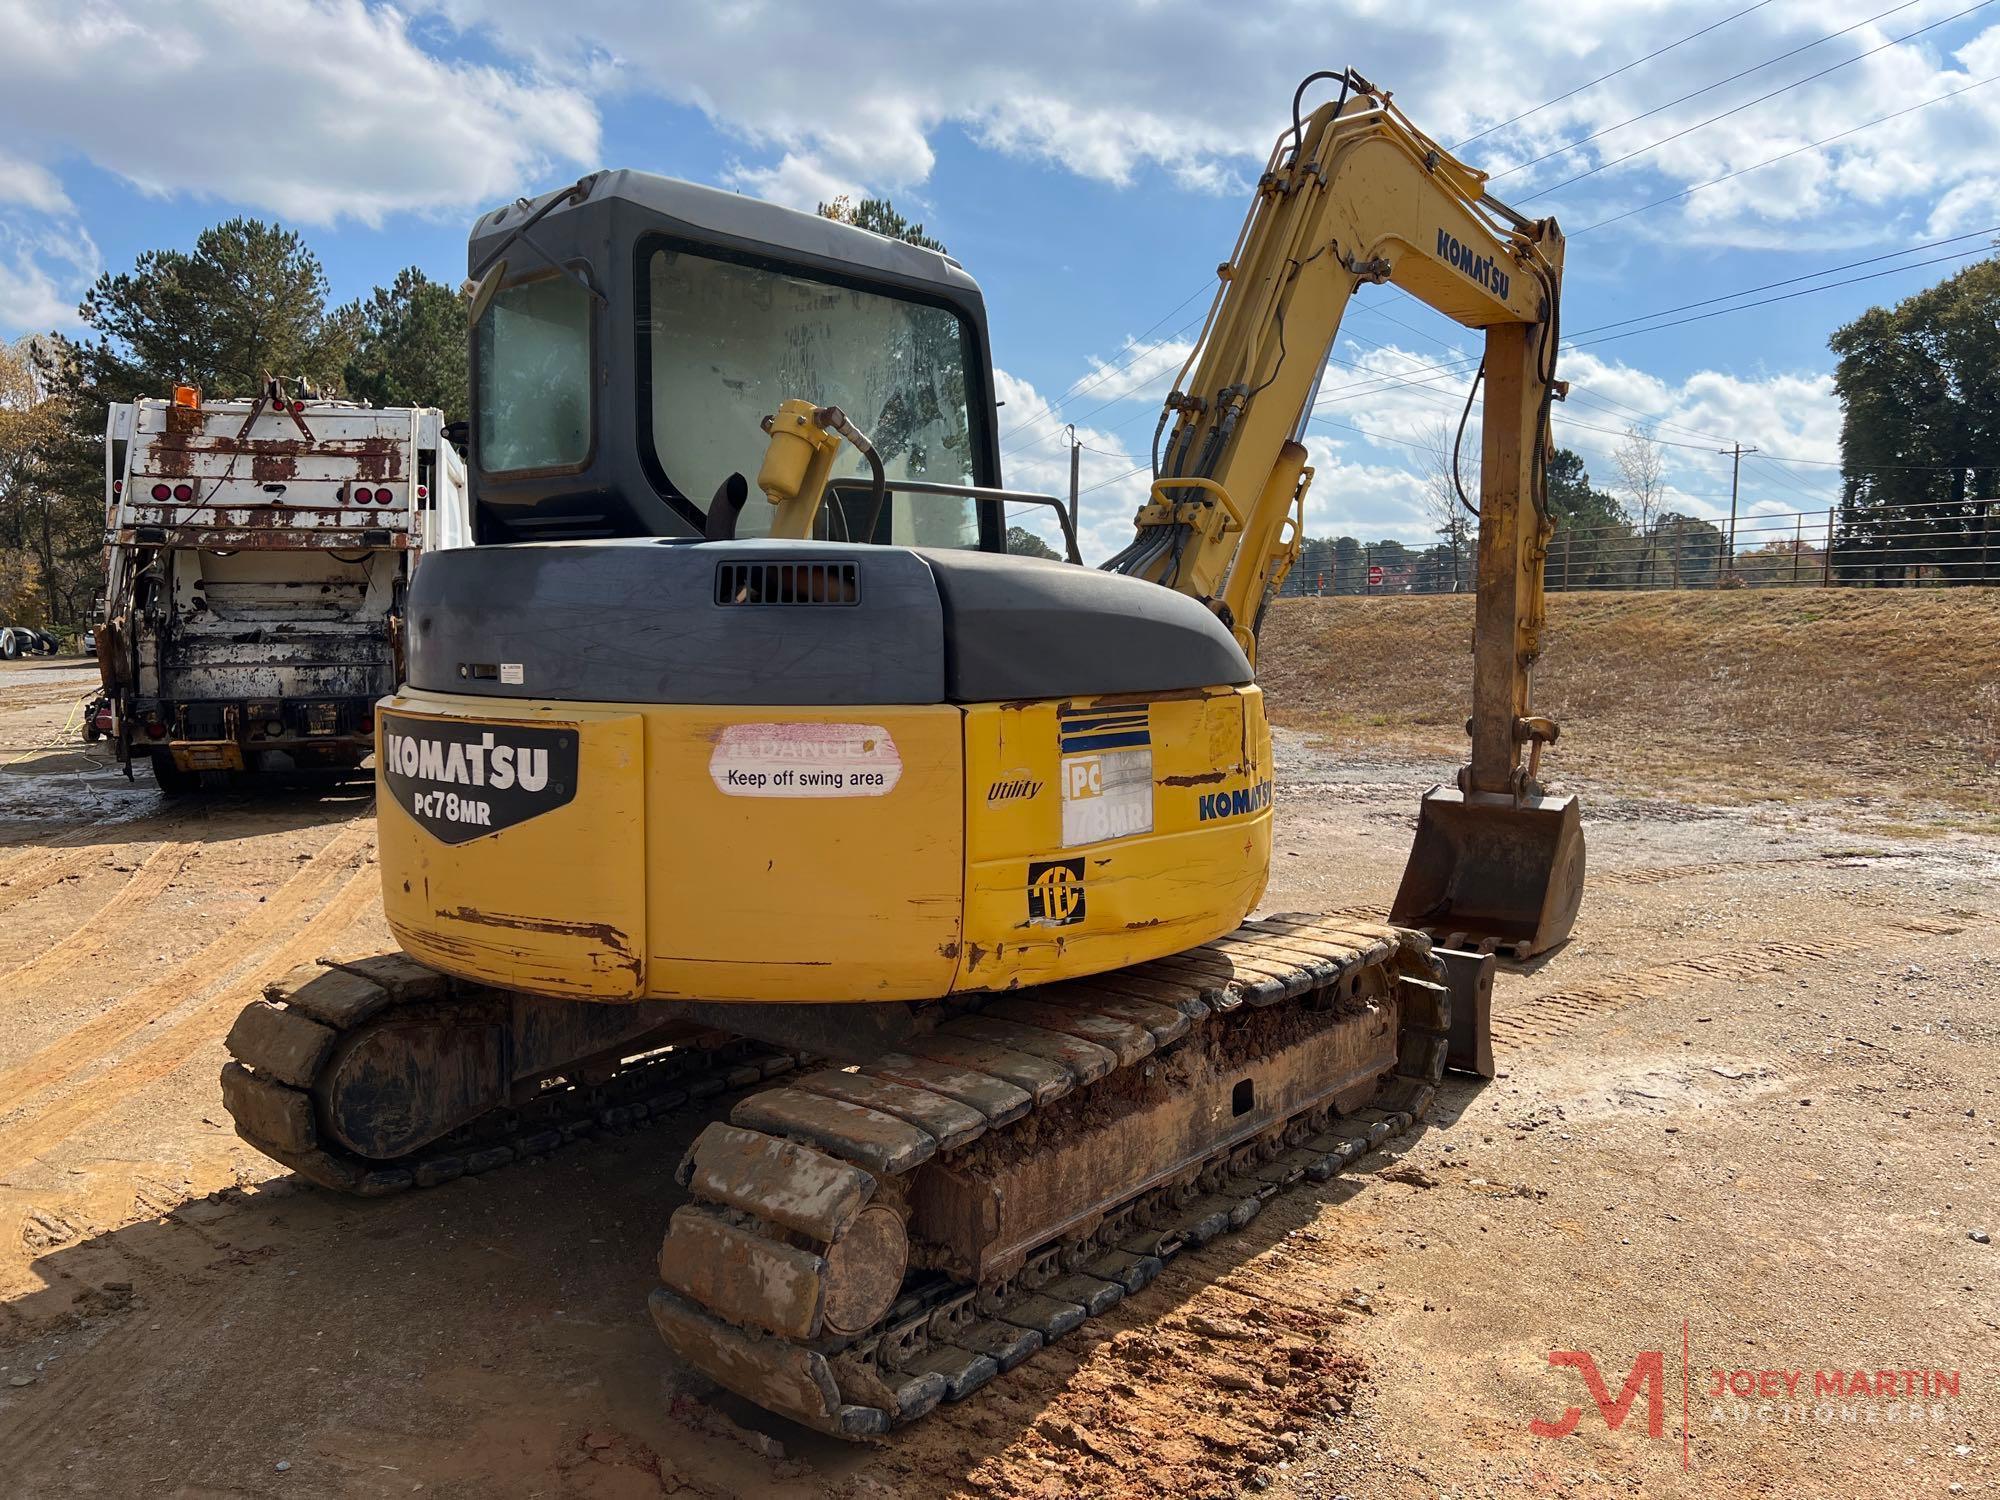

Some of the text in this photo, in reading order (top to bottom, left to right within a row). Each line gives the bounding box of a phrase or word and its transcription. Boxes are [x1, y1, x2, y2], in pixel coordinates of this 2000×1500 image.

[1437, 227, 1509, 300] KOMATSU
[388, 732, 548, 791] KOMATSU
[728, 770, 884, 788] Keep off swing area
[988, 780, 1043, 800] Utility
[1072, 764, 1101, 797] PC
[414, 790, 491, 826] PC78MR
[1073, 801, 1144, 839] 78MR
